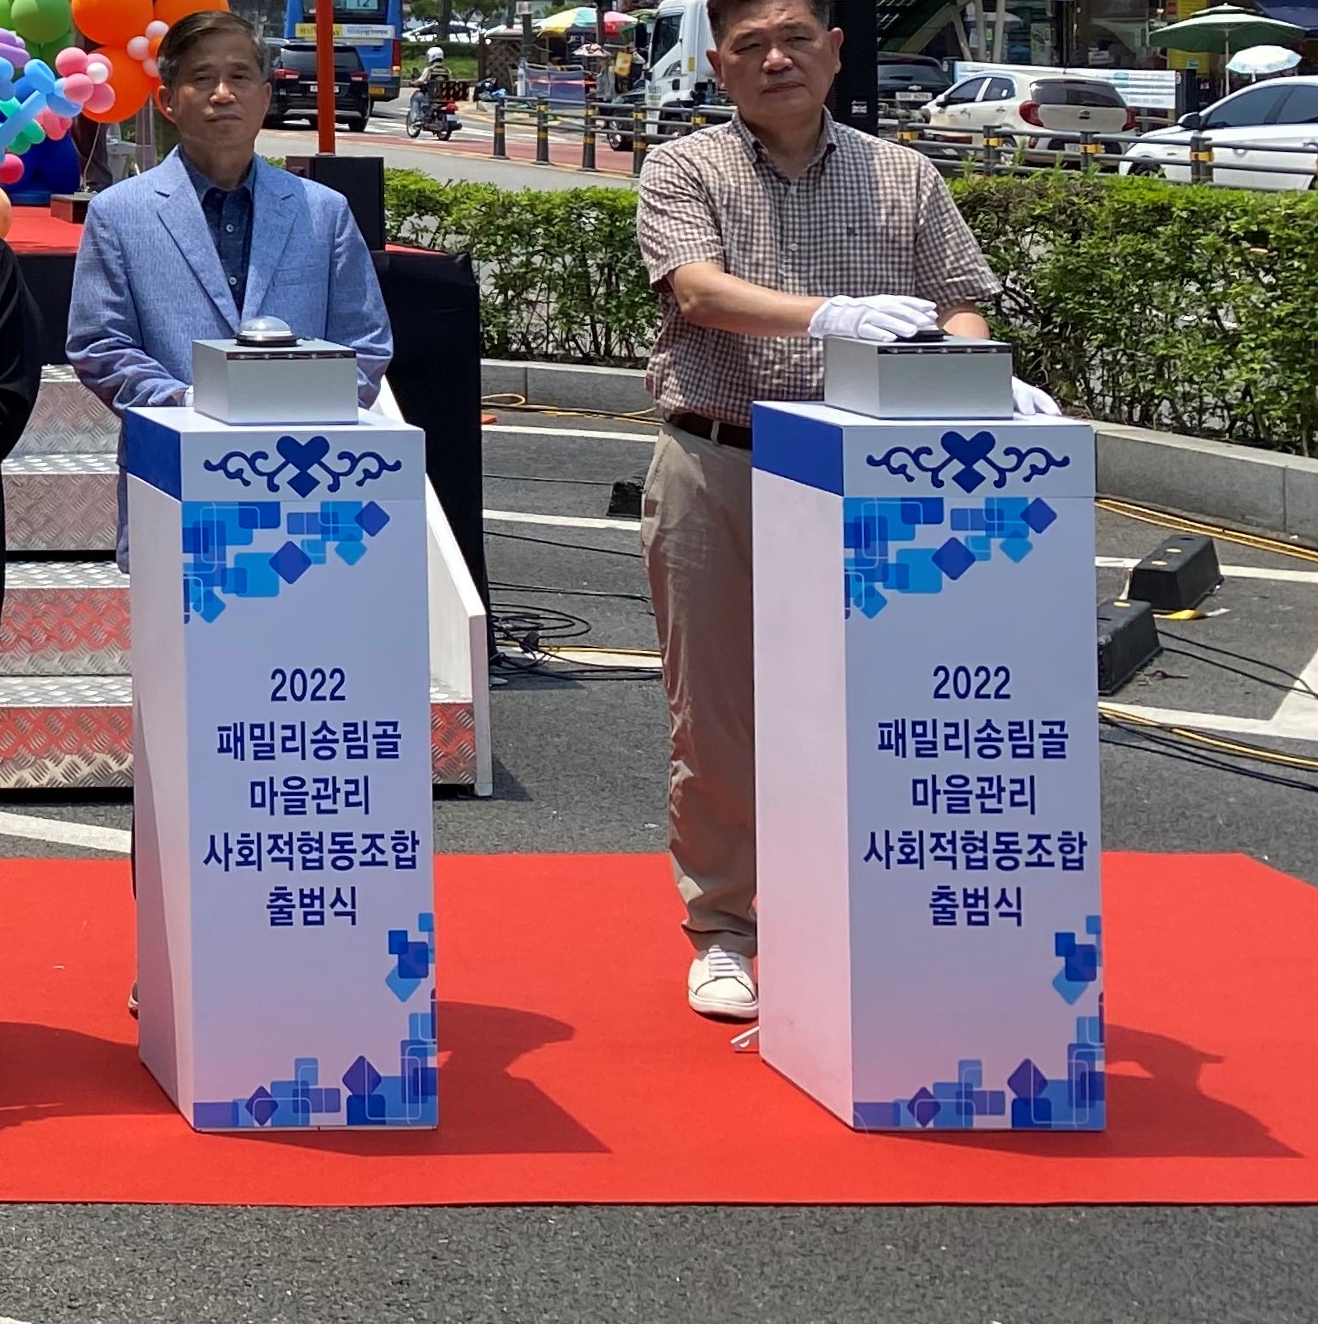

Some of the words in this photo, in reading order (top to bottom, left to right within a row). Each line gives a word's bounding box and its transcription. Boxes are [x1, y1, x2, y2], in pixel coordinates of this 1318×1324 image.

[270, 667, 346, 702] 2022
[933, 665, 1011, 700] 2022
[217, 720, 402, 762] 패밀리송림골
[877, 718, 1069, 760] 패밀리송림골
[250, 775, 370, 816] 마을관리
[911, 774, 1036, 816] 마을관리
[203, 829, 420, 872] 사회적협동조합
[863, 829, 1088, 872] 사회적협동조합
[266, 886, 357, 927] 출범식
[929, 885, 1022, 927] 출범식
